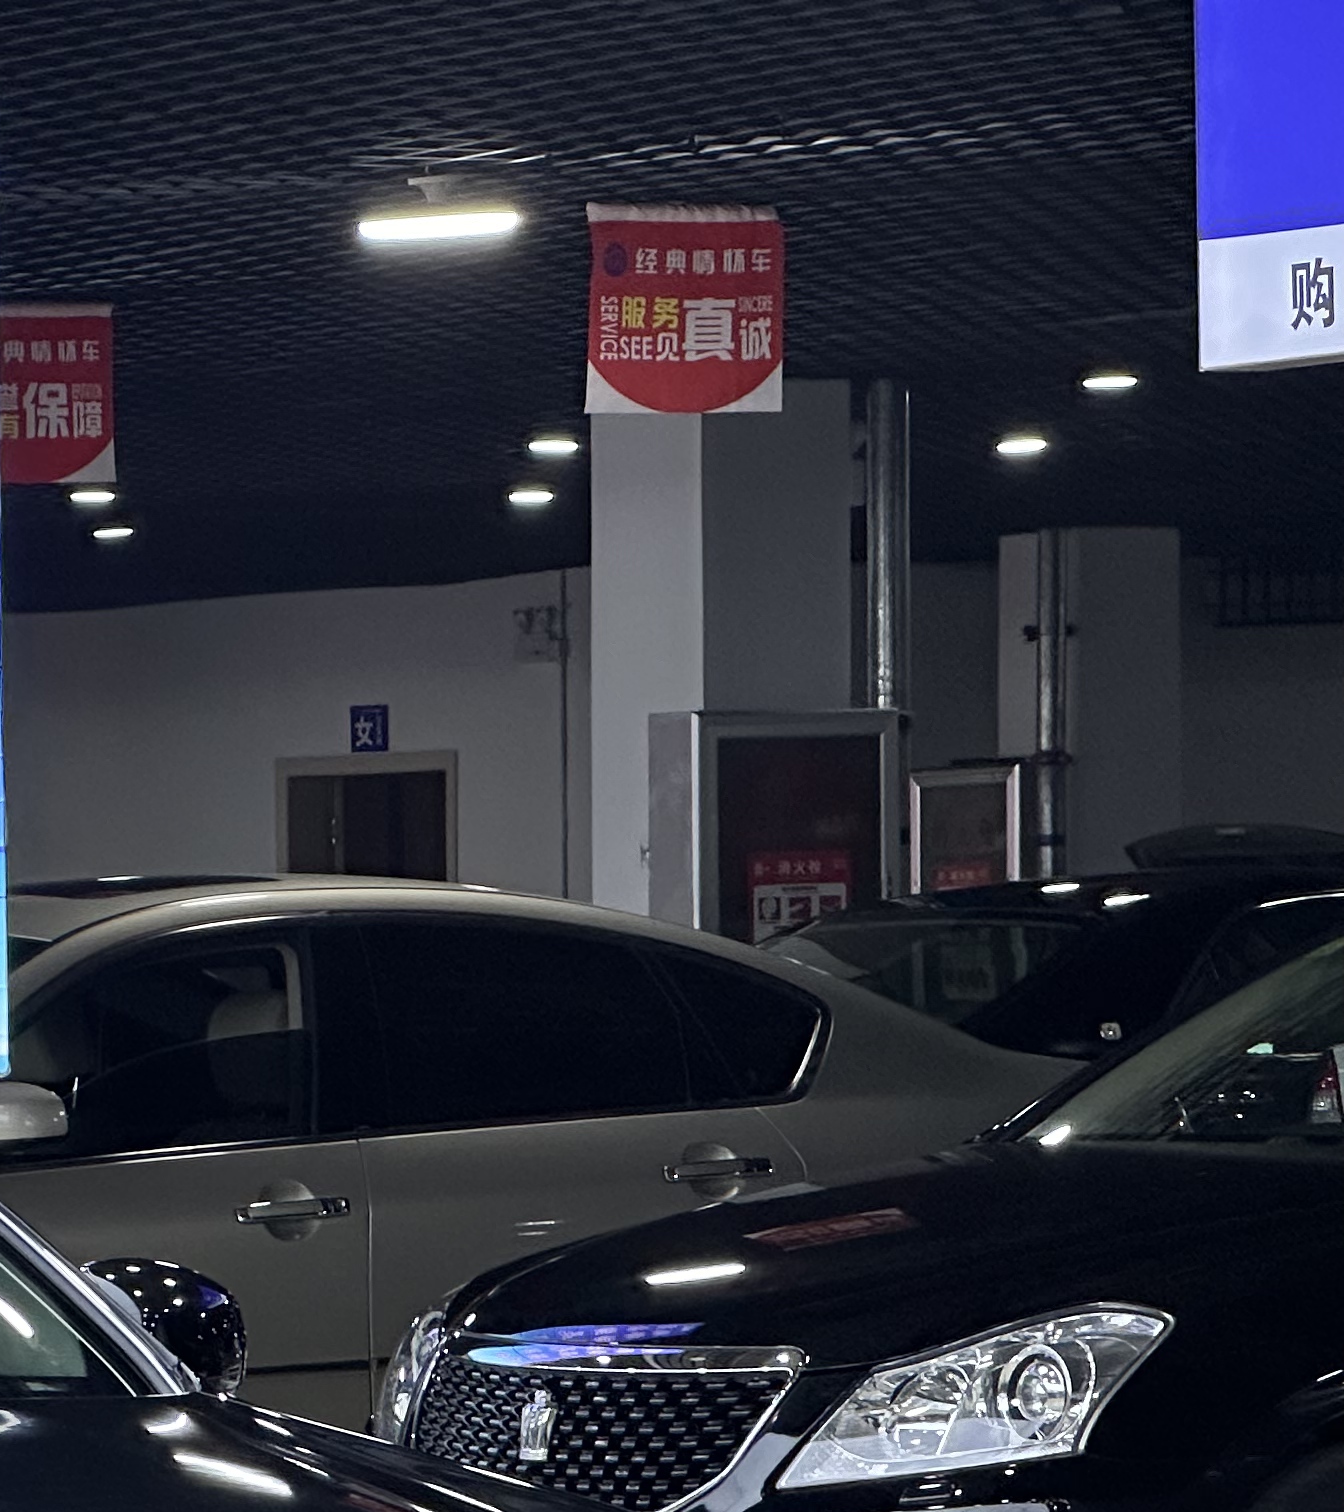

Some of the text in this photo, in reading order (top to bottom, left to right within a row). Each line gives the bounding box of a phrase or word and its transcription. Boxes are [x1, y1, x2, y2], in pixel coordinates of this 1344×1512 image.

[621, 295, 680, 329] 服务
[1290, 257, 1336, 331] 购
[599, 295, 619, 361] SERVICE
[22, 382, 103, 440] 保障
[353, 715, 374, 748] 女
